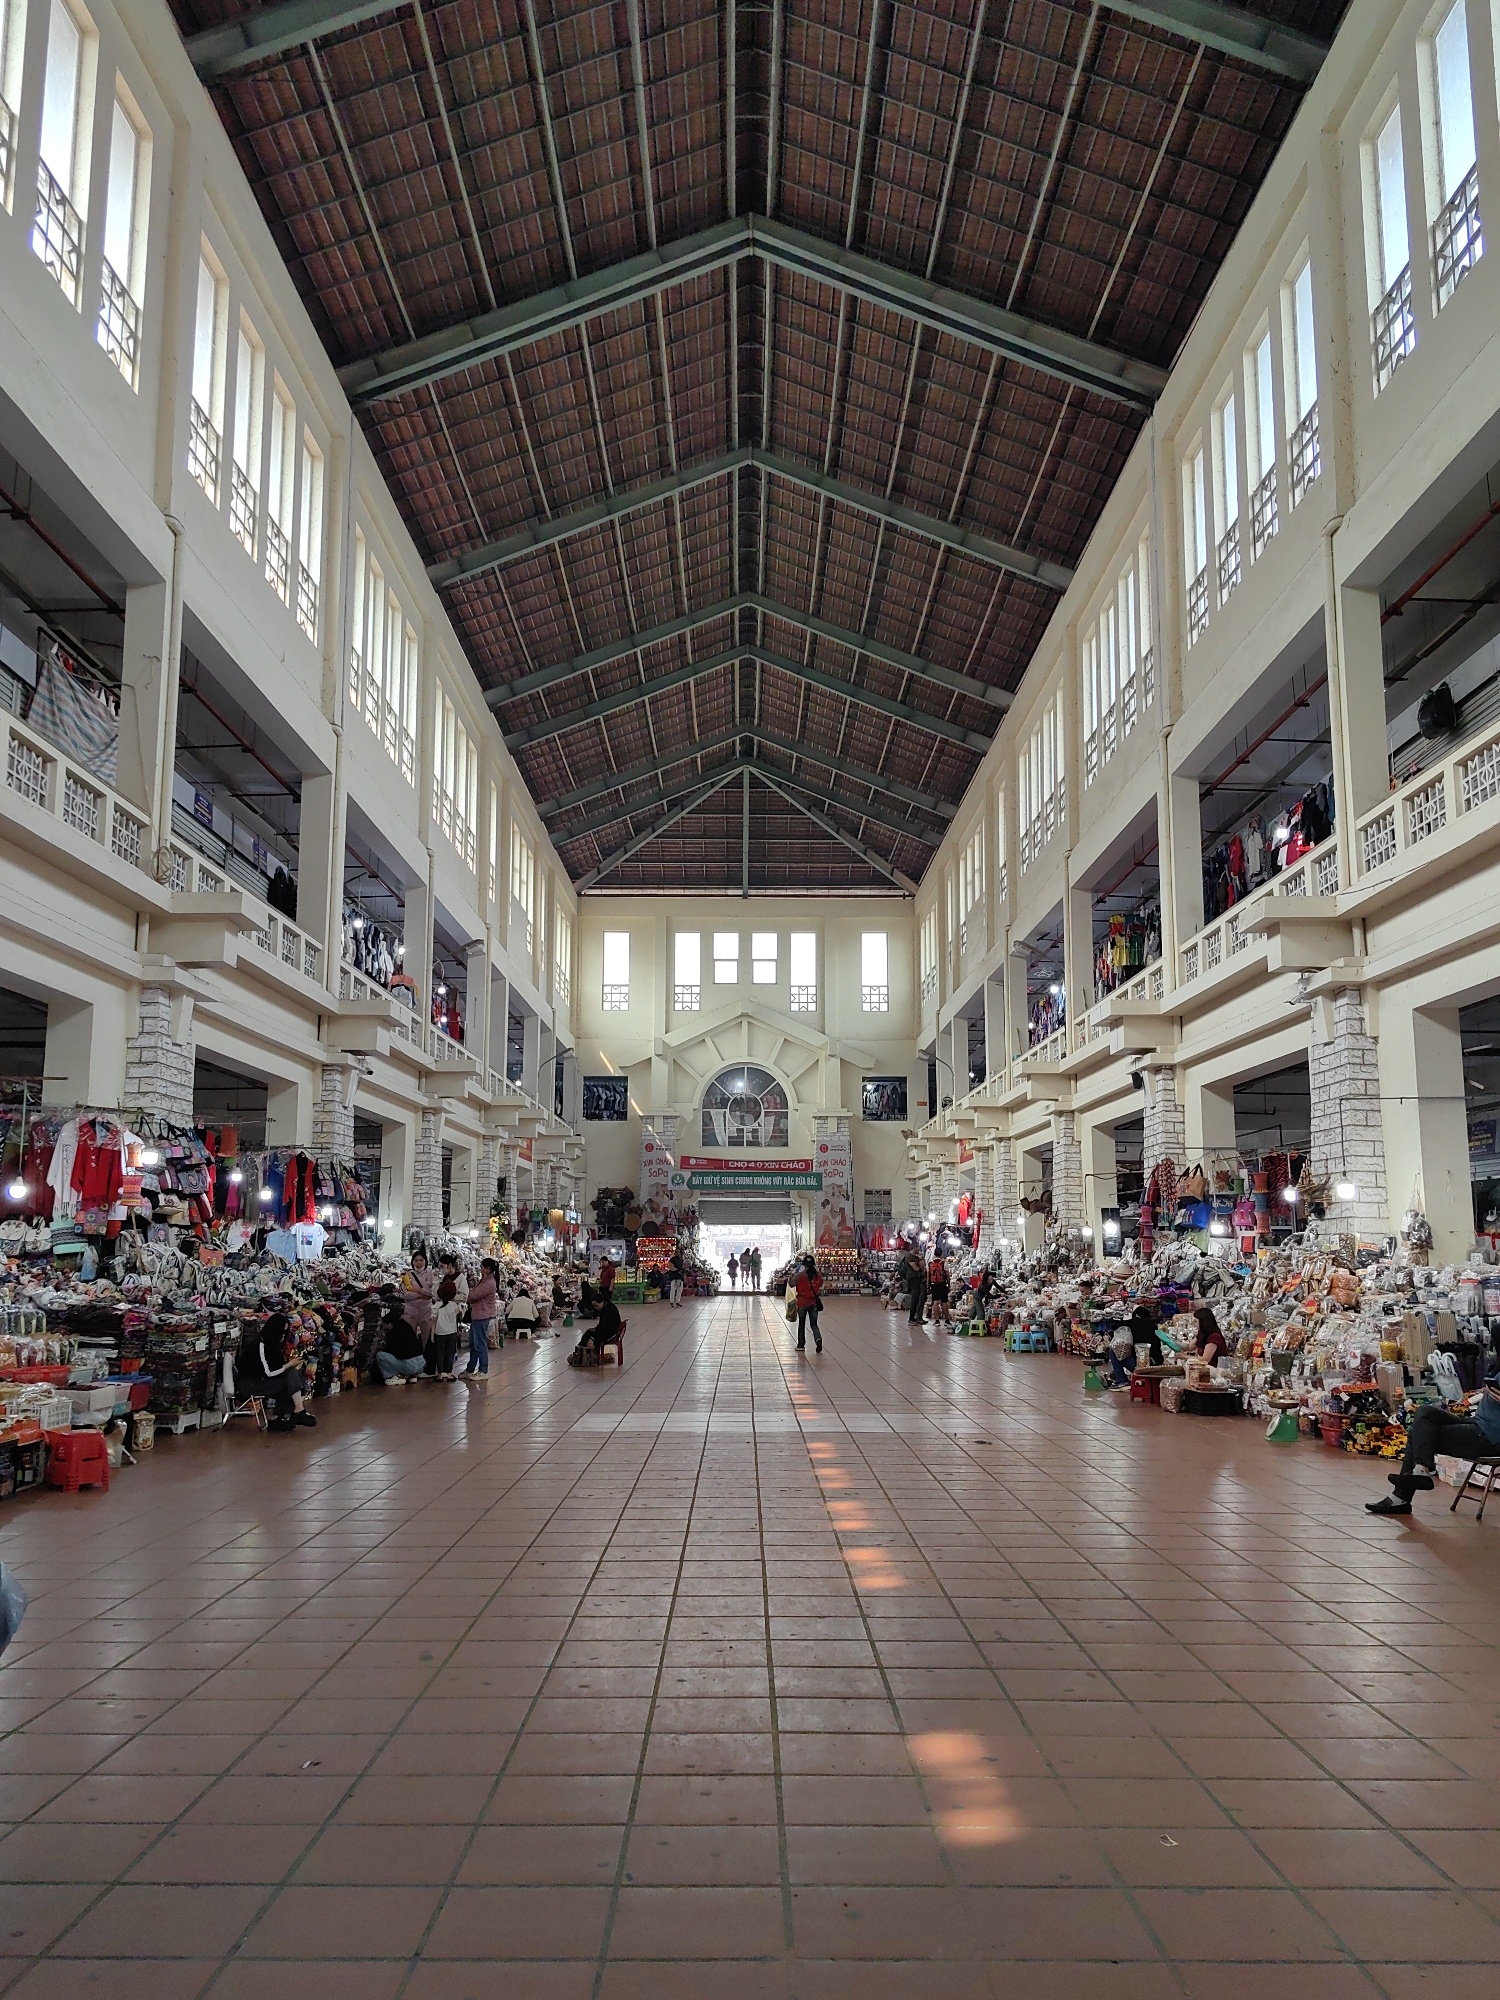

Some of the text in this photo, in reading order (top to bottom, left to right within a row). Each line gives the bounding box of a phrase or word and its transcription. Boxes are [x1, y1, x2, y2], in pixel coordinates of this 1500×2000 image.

[643, 1158, 654, 1168] XIN
[728, 1160, 748, 1169] CHỢ
[780, 1160, 806, 1169] CHÀO
[818, 1157, 847, 1168] XIN CHÀO
[648, 1168, 669, 1177] SaPa
[823, 1169, 844, 1178] SaPa
[713, 1174, 721, 1187] VỆ
[721, 1176, 735, 1185] SINH
[734, 1176, 753, 1185] CHUNG
